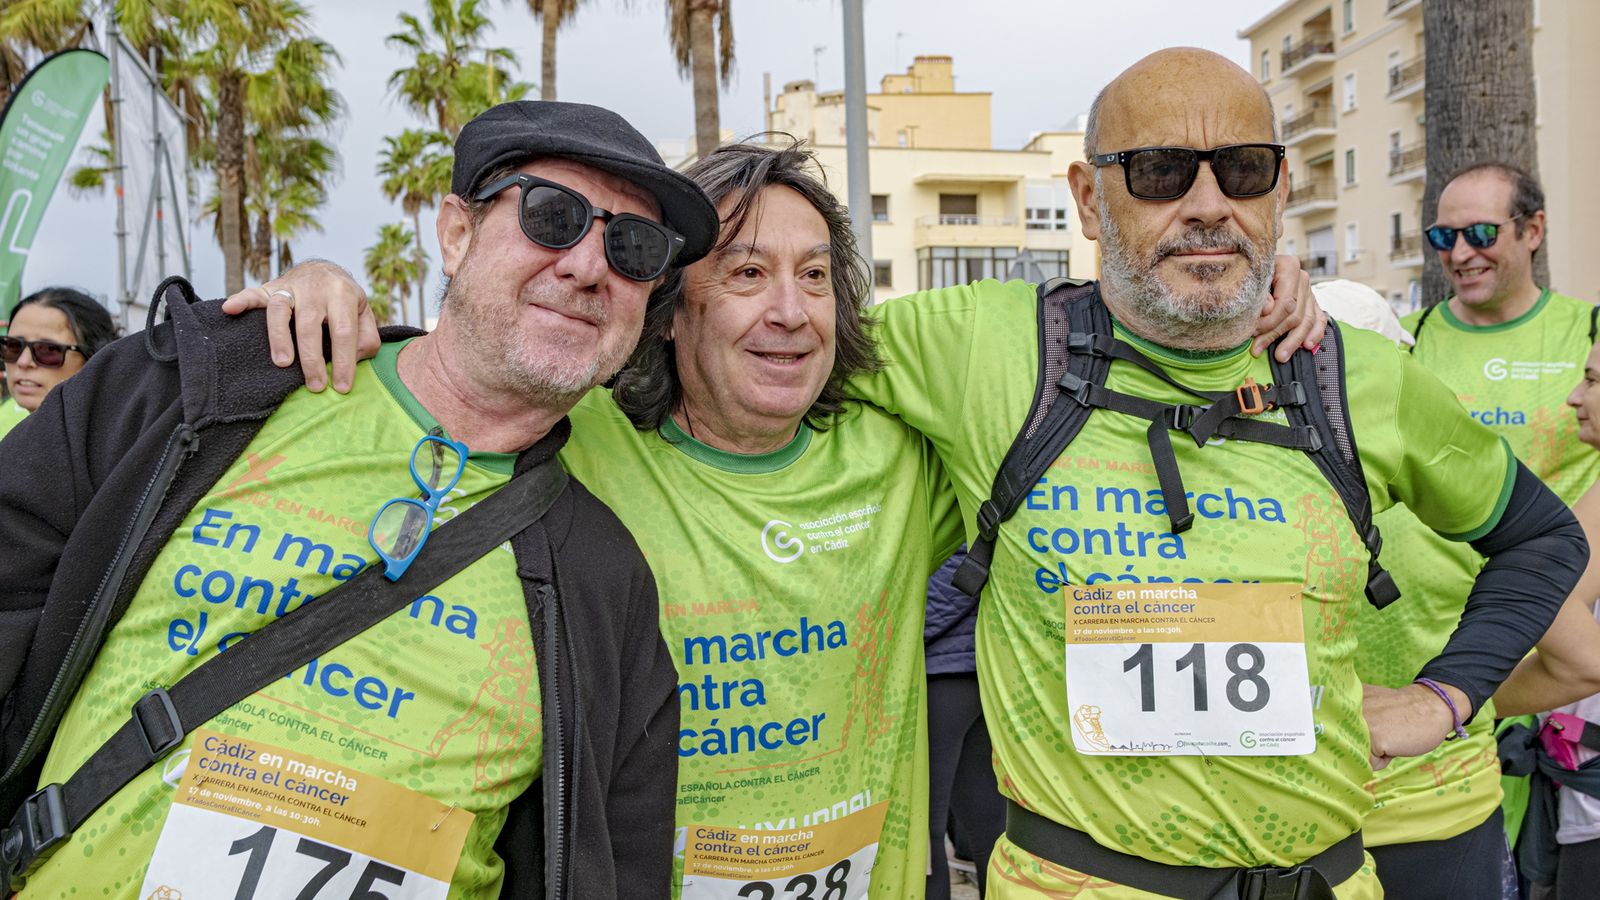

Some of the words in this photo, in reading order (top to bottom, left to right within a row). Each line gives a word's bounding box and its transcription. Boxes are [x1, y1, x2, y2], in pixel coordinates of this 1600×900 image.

[1470, 406, 1526, 425] rcha
[1026, 477, 1078, 511] En
[1096, 487, 1287, 523] macha
[192, 508, 261, 553] En
[1027, 521, 1186, 560] contra
[173, 564, 319, 618] cont
[1073, 588, 1113, 601] Cádiz
[1116, 589, 1136, 600] en
[1140, 587, 1197, 600] marcha
[1073, 602, 1120, 615] contra
[1125, 601, 1140, 614] el
[1143, 601, 1196, 613] cáncer
[167, 611, 208, 655] el
[683, 617, 848, 665] marcha
[1083, 627, 1093, 635] de
[677, 674, 767, 711] ntra
[1123, 643, 1271, 713] 118
[269, 711, 318, 737] CONTRA
[320, 730, 335, 743] EL
[338, 737, 388, 761] CÁNCER
[678, 713, 826, 757] cáncer
[199, 756, 257, 781] contra
[261, 771, 281, 787] el
[284, 778, 349, 806] cáncer
[204, 736, 256, 761] Cádiz
[258, 752, 283, 767] en
[286, 759, 357, 792] marcha
[680, 780, 732, 793] ESPAÑOLA
[733, 776, 772, 789] CONTRA
[774, 775, 785, 783] EL
[787, 766, 820, 781] CÁNCER
[200, 788, 211, 798] de
[265, 804, 272, 812] a
[273, 805, 288, 816] las
[237, 784, 249, 793] EN
[250, 787, 286, 802] MARCHA
[287, 797, 321, 812] CONTRA
[322, 808, 332, 816] EL
[334, 810, 367, 828] CÁNCER
[695, 842, 742, 855] contra
[746, 845, 760, 856] el
[764, 841, 812, 856] cáncer
[696, 828, 737, 842] Cádiz
[740, 834, 758, 843] en
[763, 830, 814, 844] marcha
[699, 854, 729, 862] CARRERA
[740, 857, 768, 865] MARCHA
[768, 855, 793, 864] CONTRA
